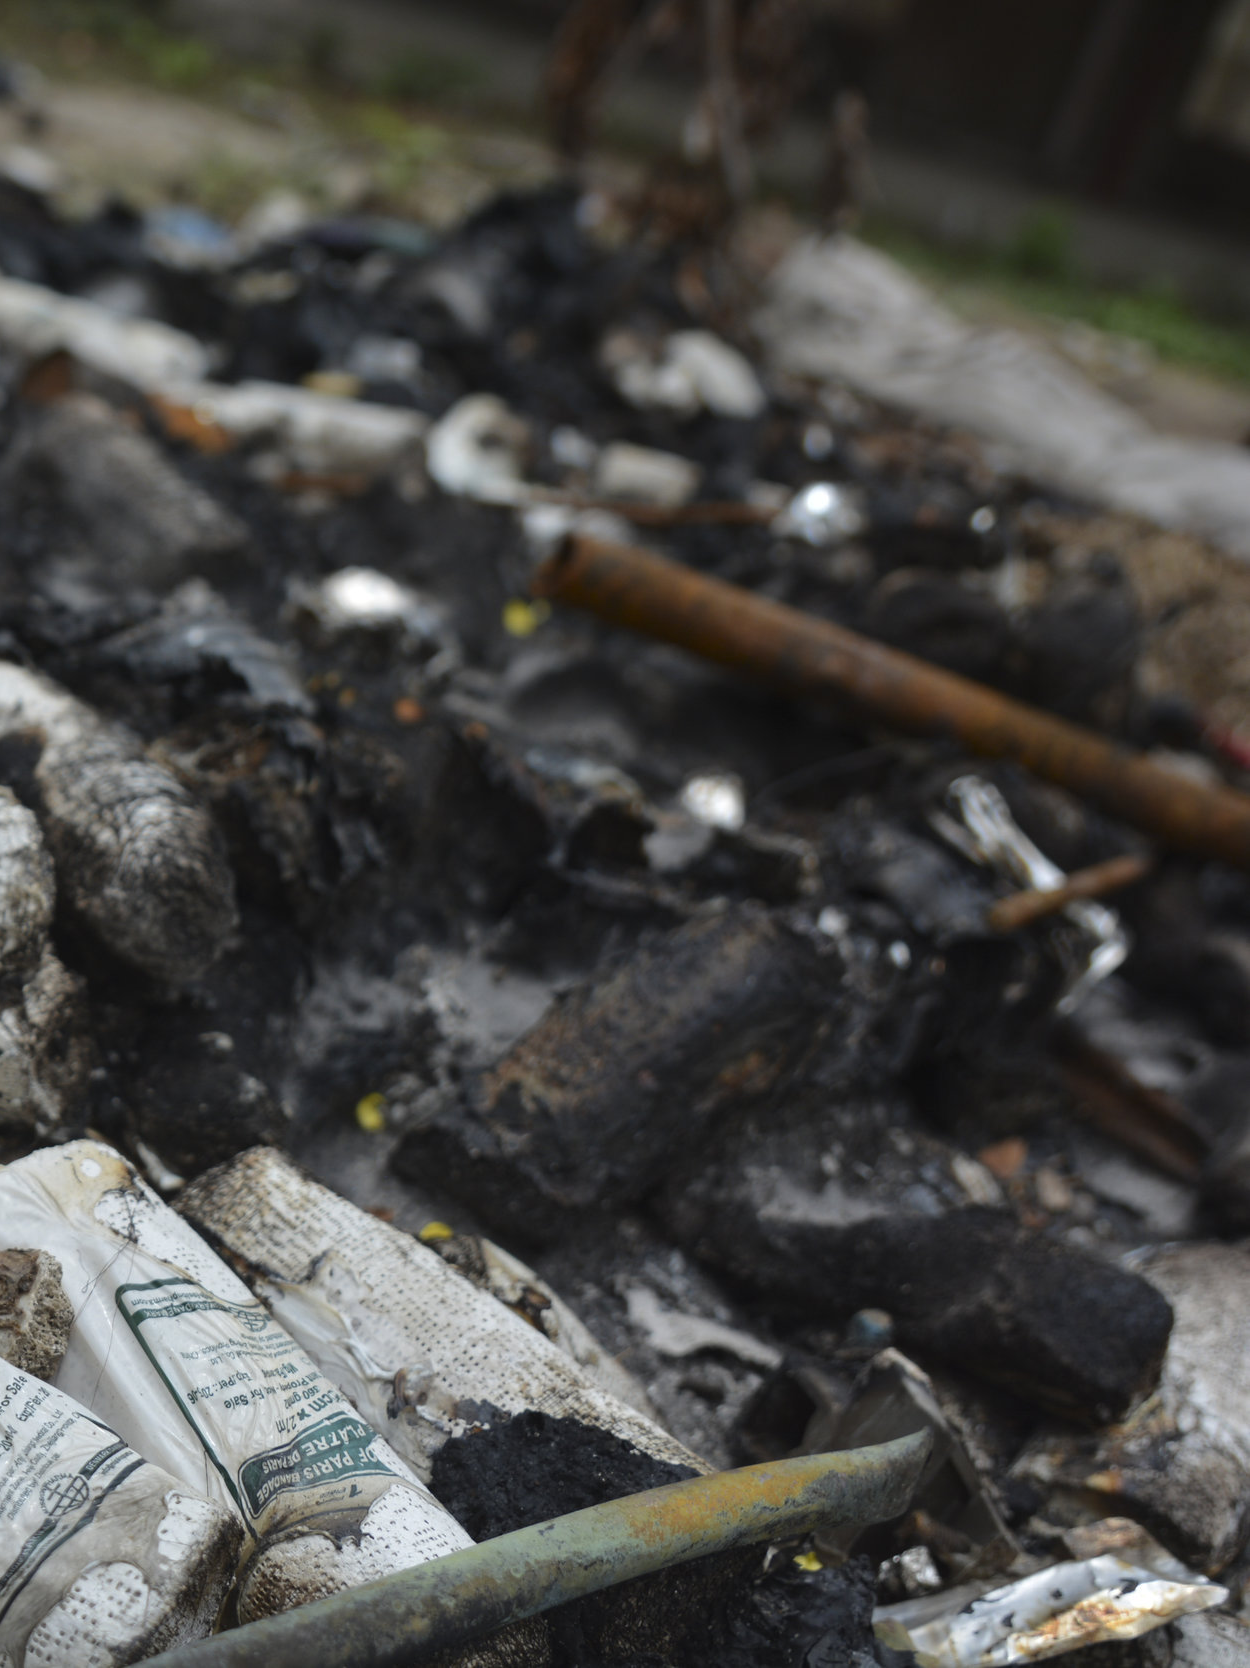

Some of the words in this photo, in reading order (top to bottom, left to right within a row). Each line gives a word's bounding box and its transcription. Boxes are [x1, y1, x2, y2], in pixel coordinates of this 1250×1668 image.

[222, 1394, 247, 1409] Sale
[295, 1407, 309, 1421] x
[301, 1423, 365, 1456] PLÂTRE
[261, 1455, 288, 1474] PARIS
[286, 1449, 301, 1463] DE
[302, 1449, 353, 1482] PARIS
[255, 1471, 301, 1504] BANDAGE
